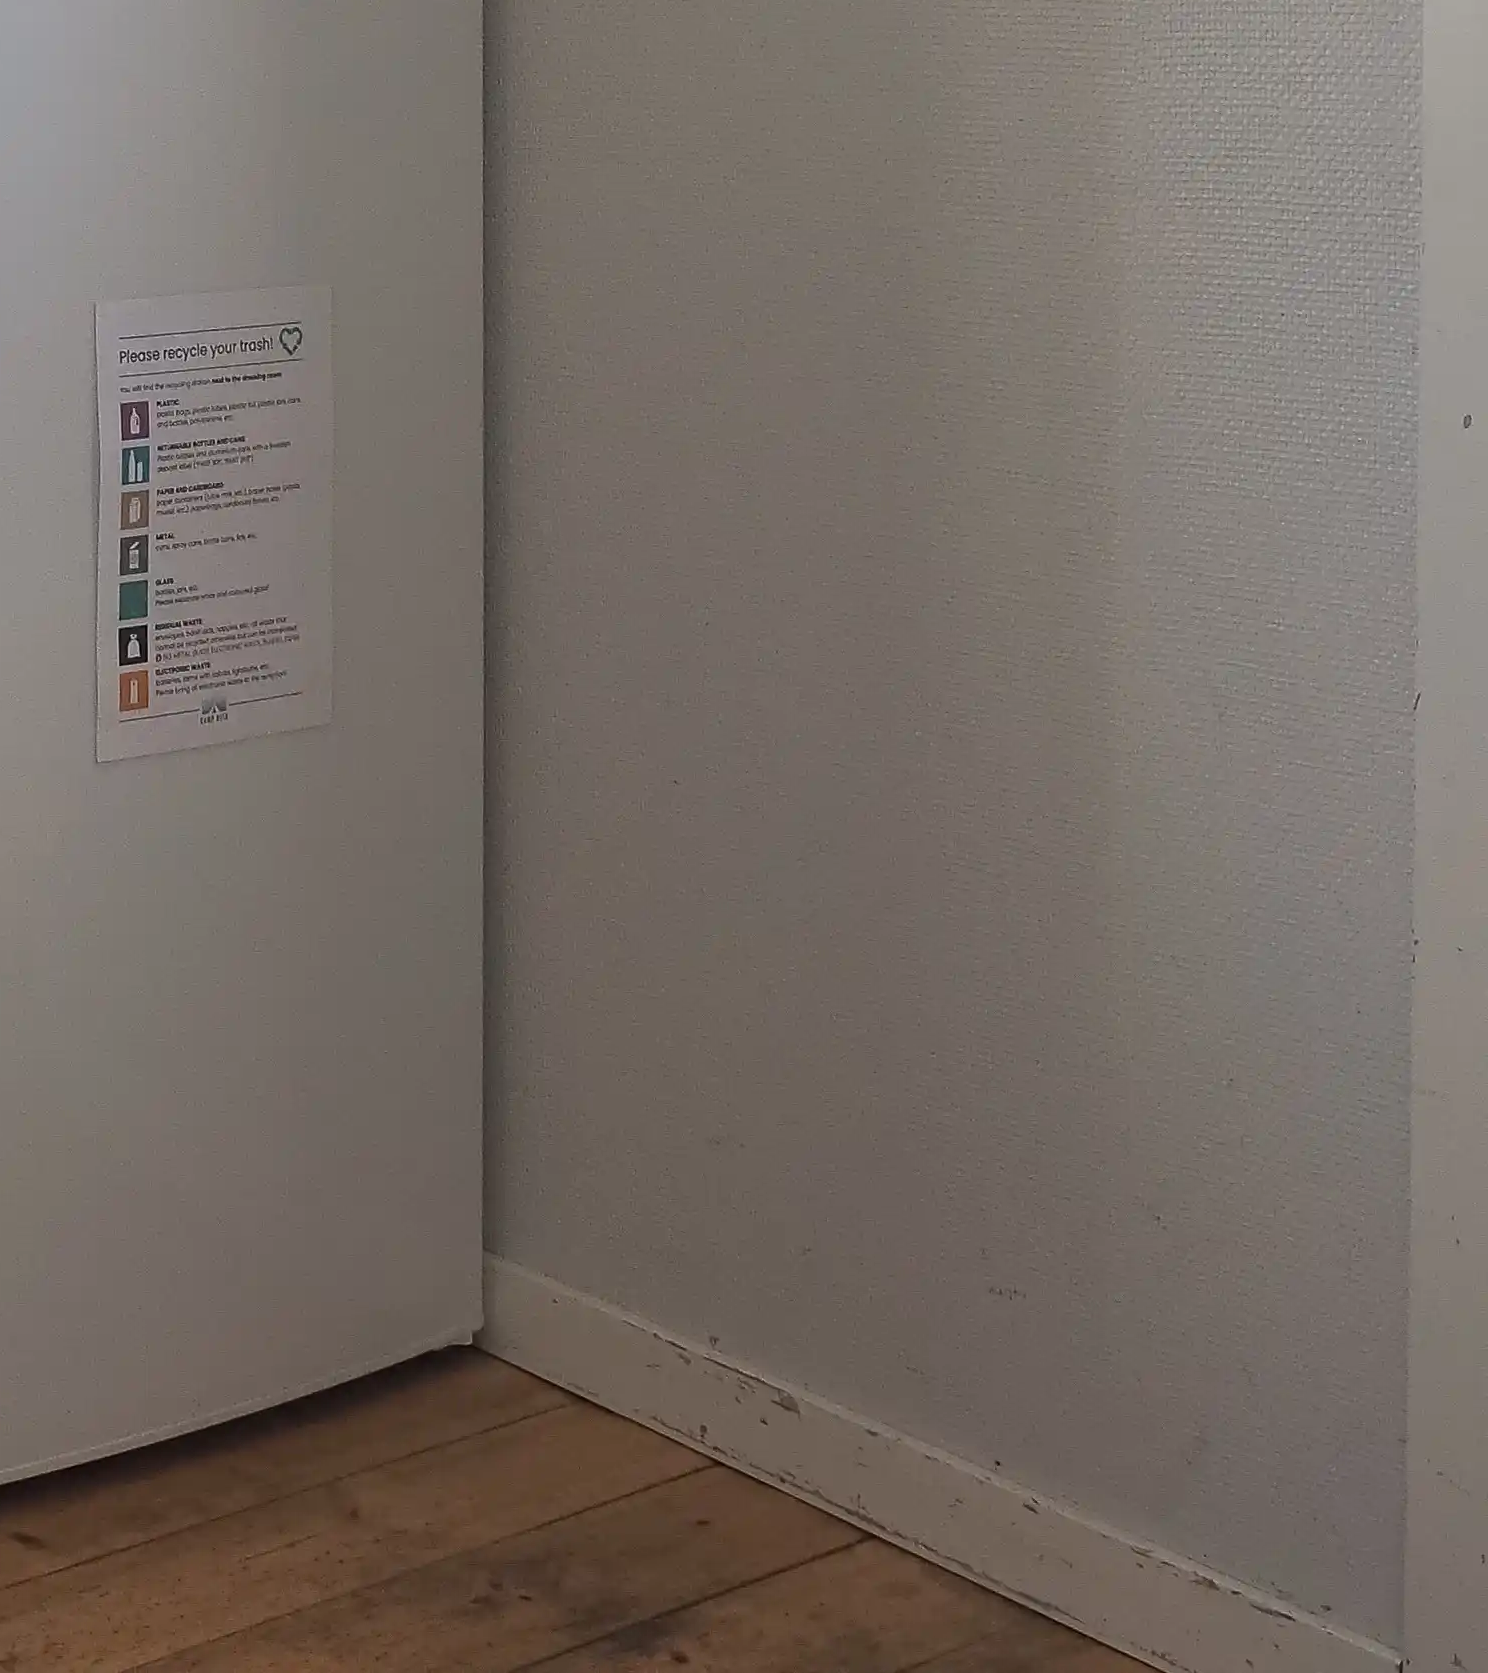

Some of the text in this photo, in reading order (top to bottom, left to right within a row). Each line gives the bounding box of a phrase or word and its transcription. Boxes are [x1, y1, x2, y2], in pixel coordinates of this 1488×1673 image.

[119, 336, 273, 367] Please recycle your trash!
